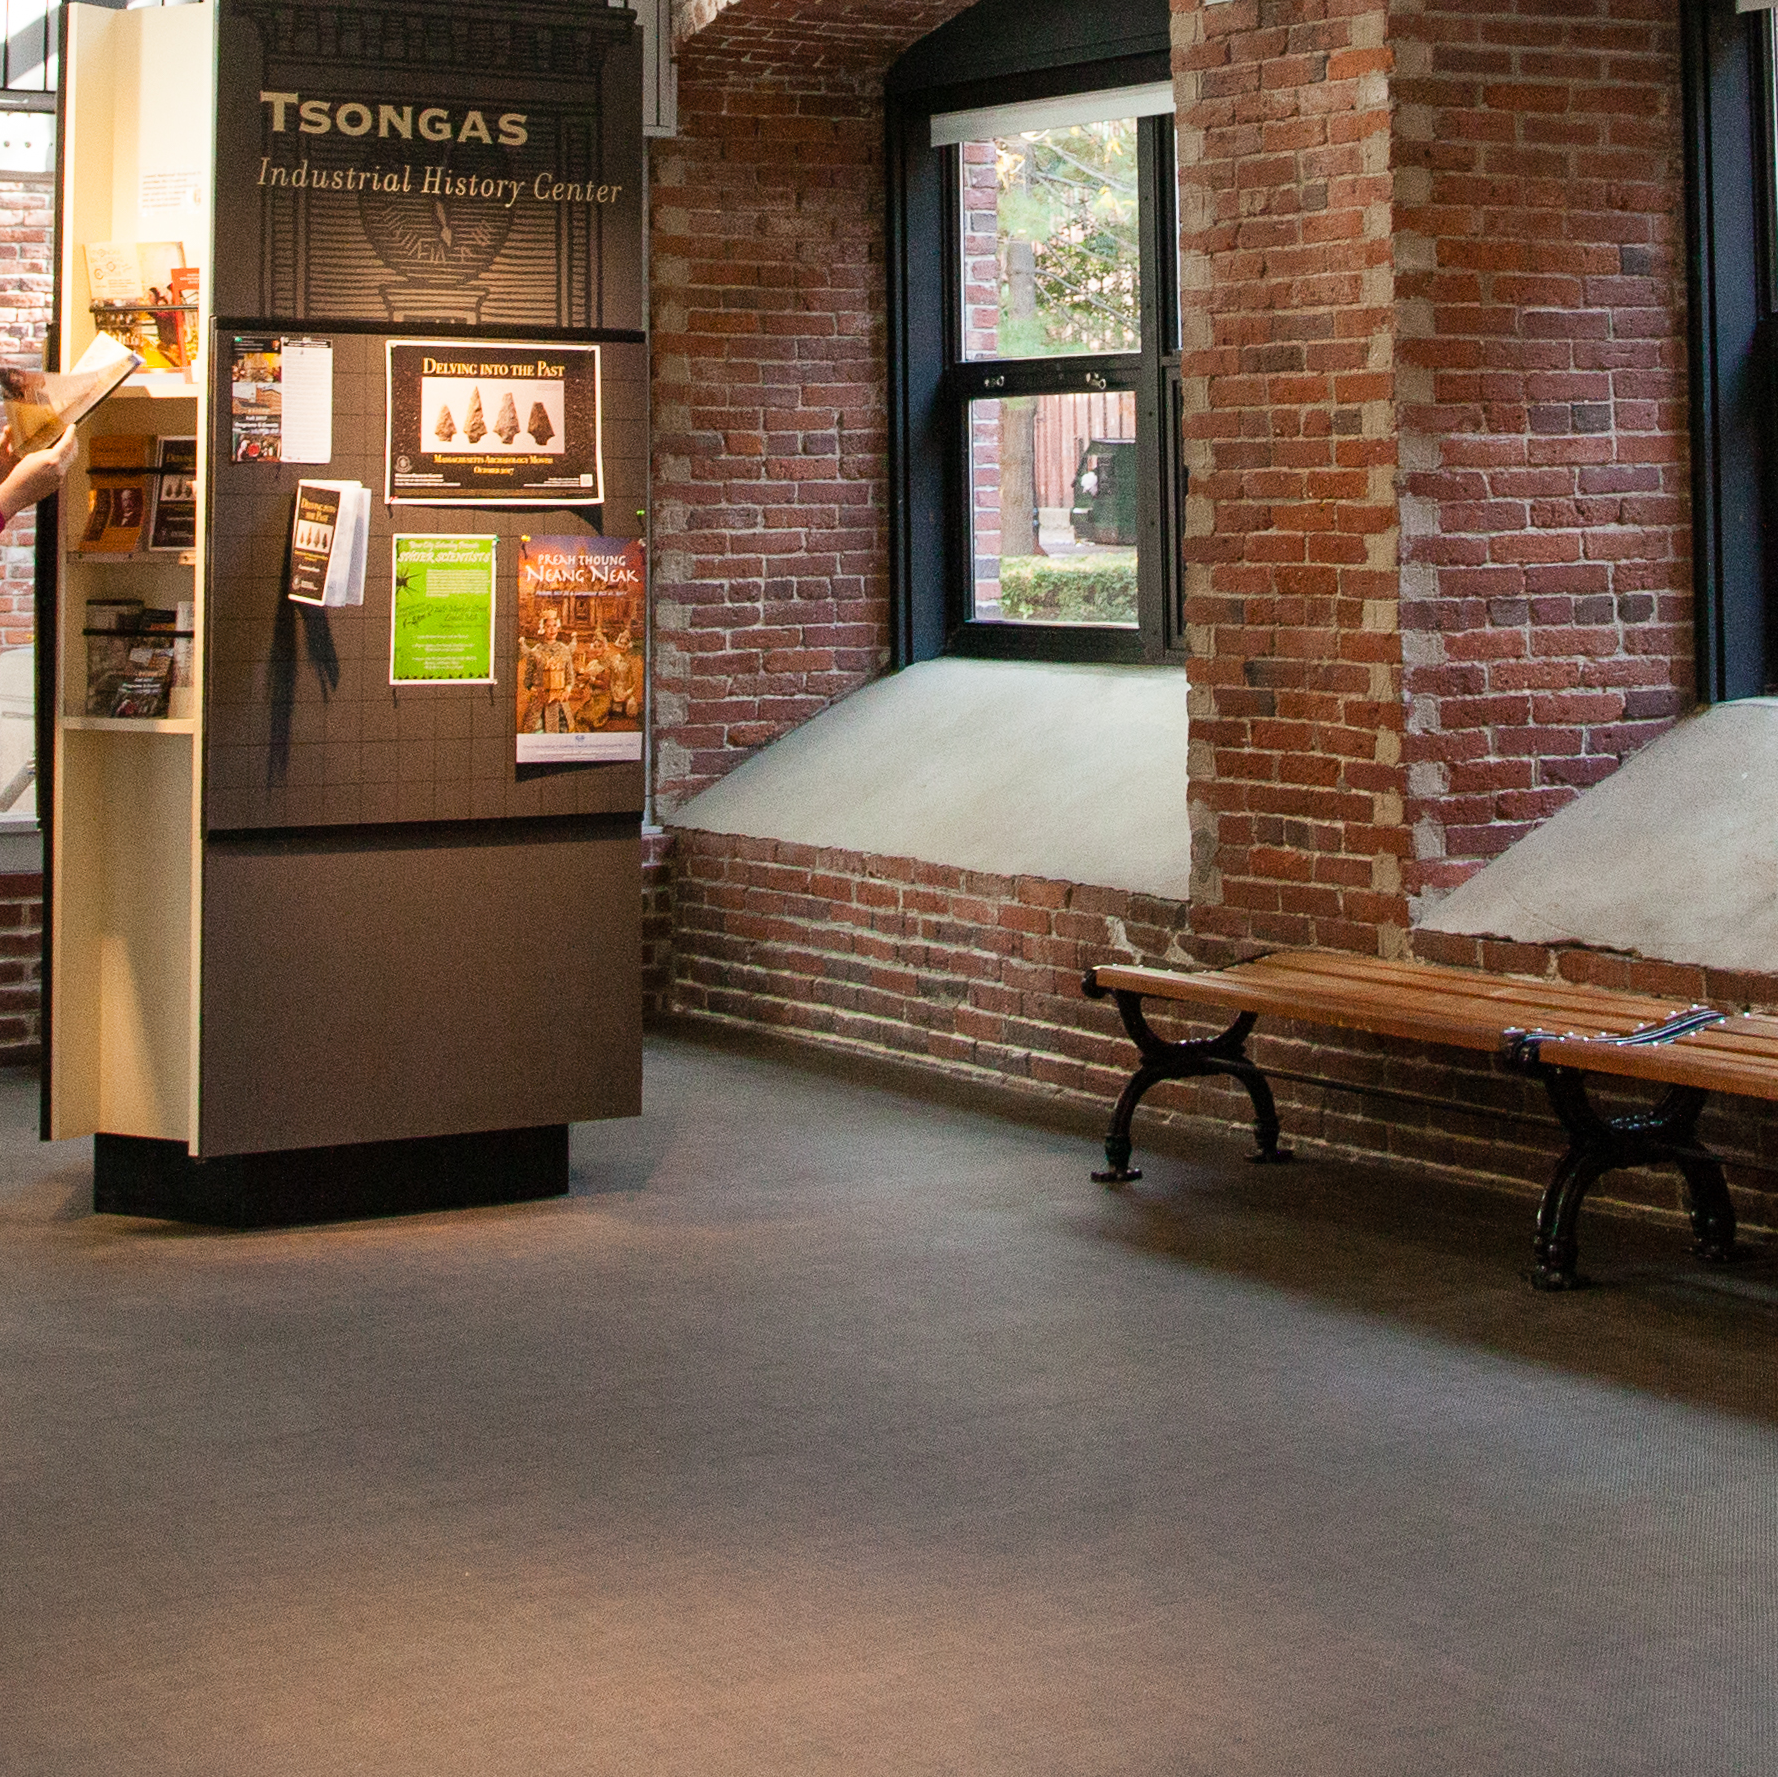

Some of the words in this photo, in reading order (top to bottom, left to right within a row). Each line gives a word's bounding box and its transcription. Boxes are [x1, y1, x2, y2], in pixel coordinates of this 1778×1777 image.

[259, 90, 528, 146] TSONGAS
[257, 157, 412, 194] Industrial
[421, 166, 525, 208] History
[533, 172, 623, 204] Center
[422, 357, 478, 375] DELVING
[480, 365, 508, 376] INTO
[510, 365, 535, 377] THE
[537, 360, 565, 377] PAST
[538, 554, 576, 566] PREAH
[578, 555, 626, 567] THOUNG
[525, 565, 584, 583] NEANG
[589, 565, 639, 583] NEAK
